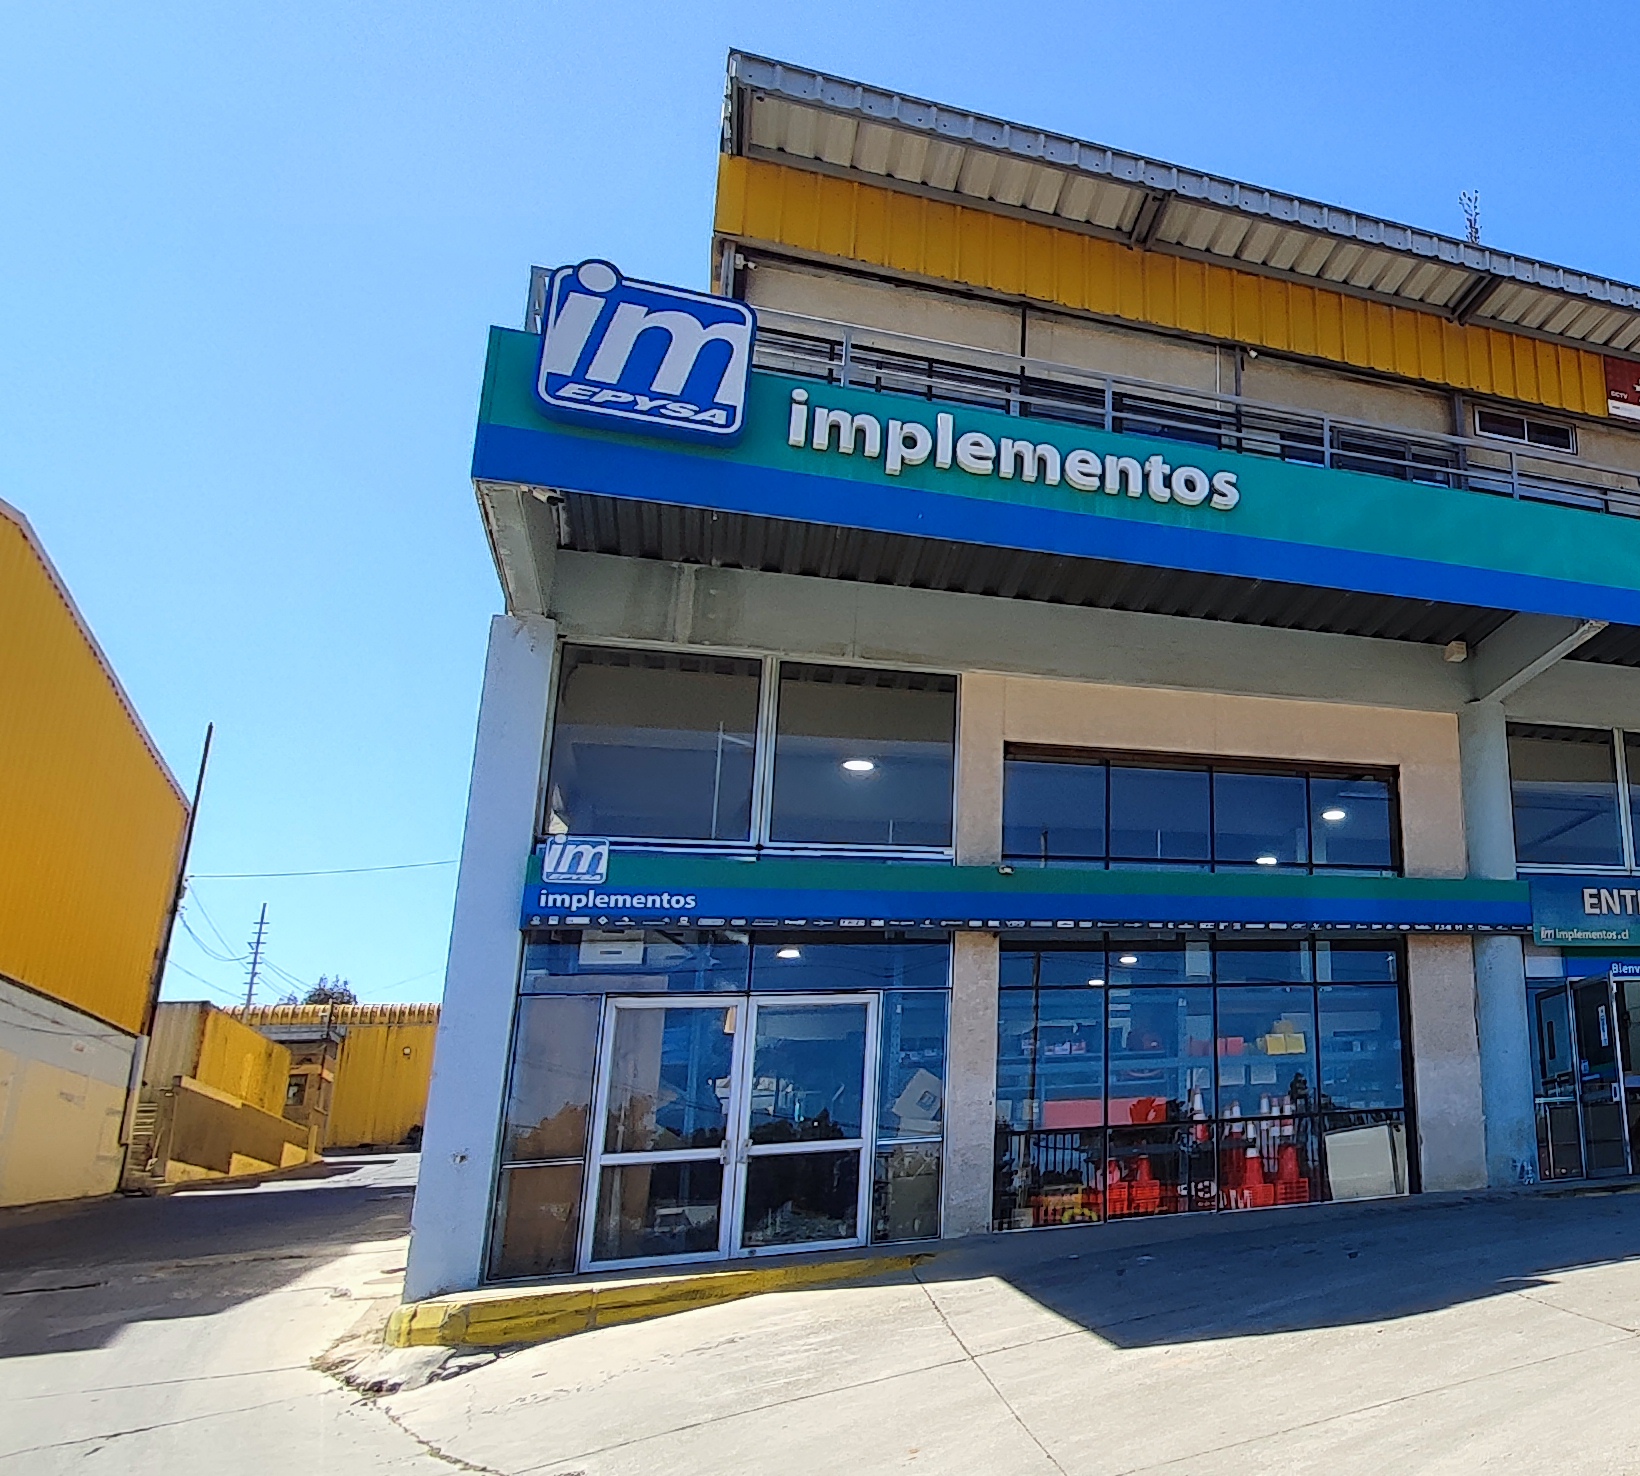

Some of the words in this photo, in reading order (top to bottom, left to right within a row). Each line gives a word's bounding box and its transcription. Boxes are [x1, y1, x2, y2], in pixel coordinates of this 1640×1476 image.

[546, 261, 747, 406] im
[556, 382, 727, 425] EPYSA
[788, 388, 1241, 511] implementos
[546, 833, 608, 873] im
[539, 889, 697, 912] implementos
